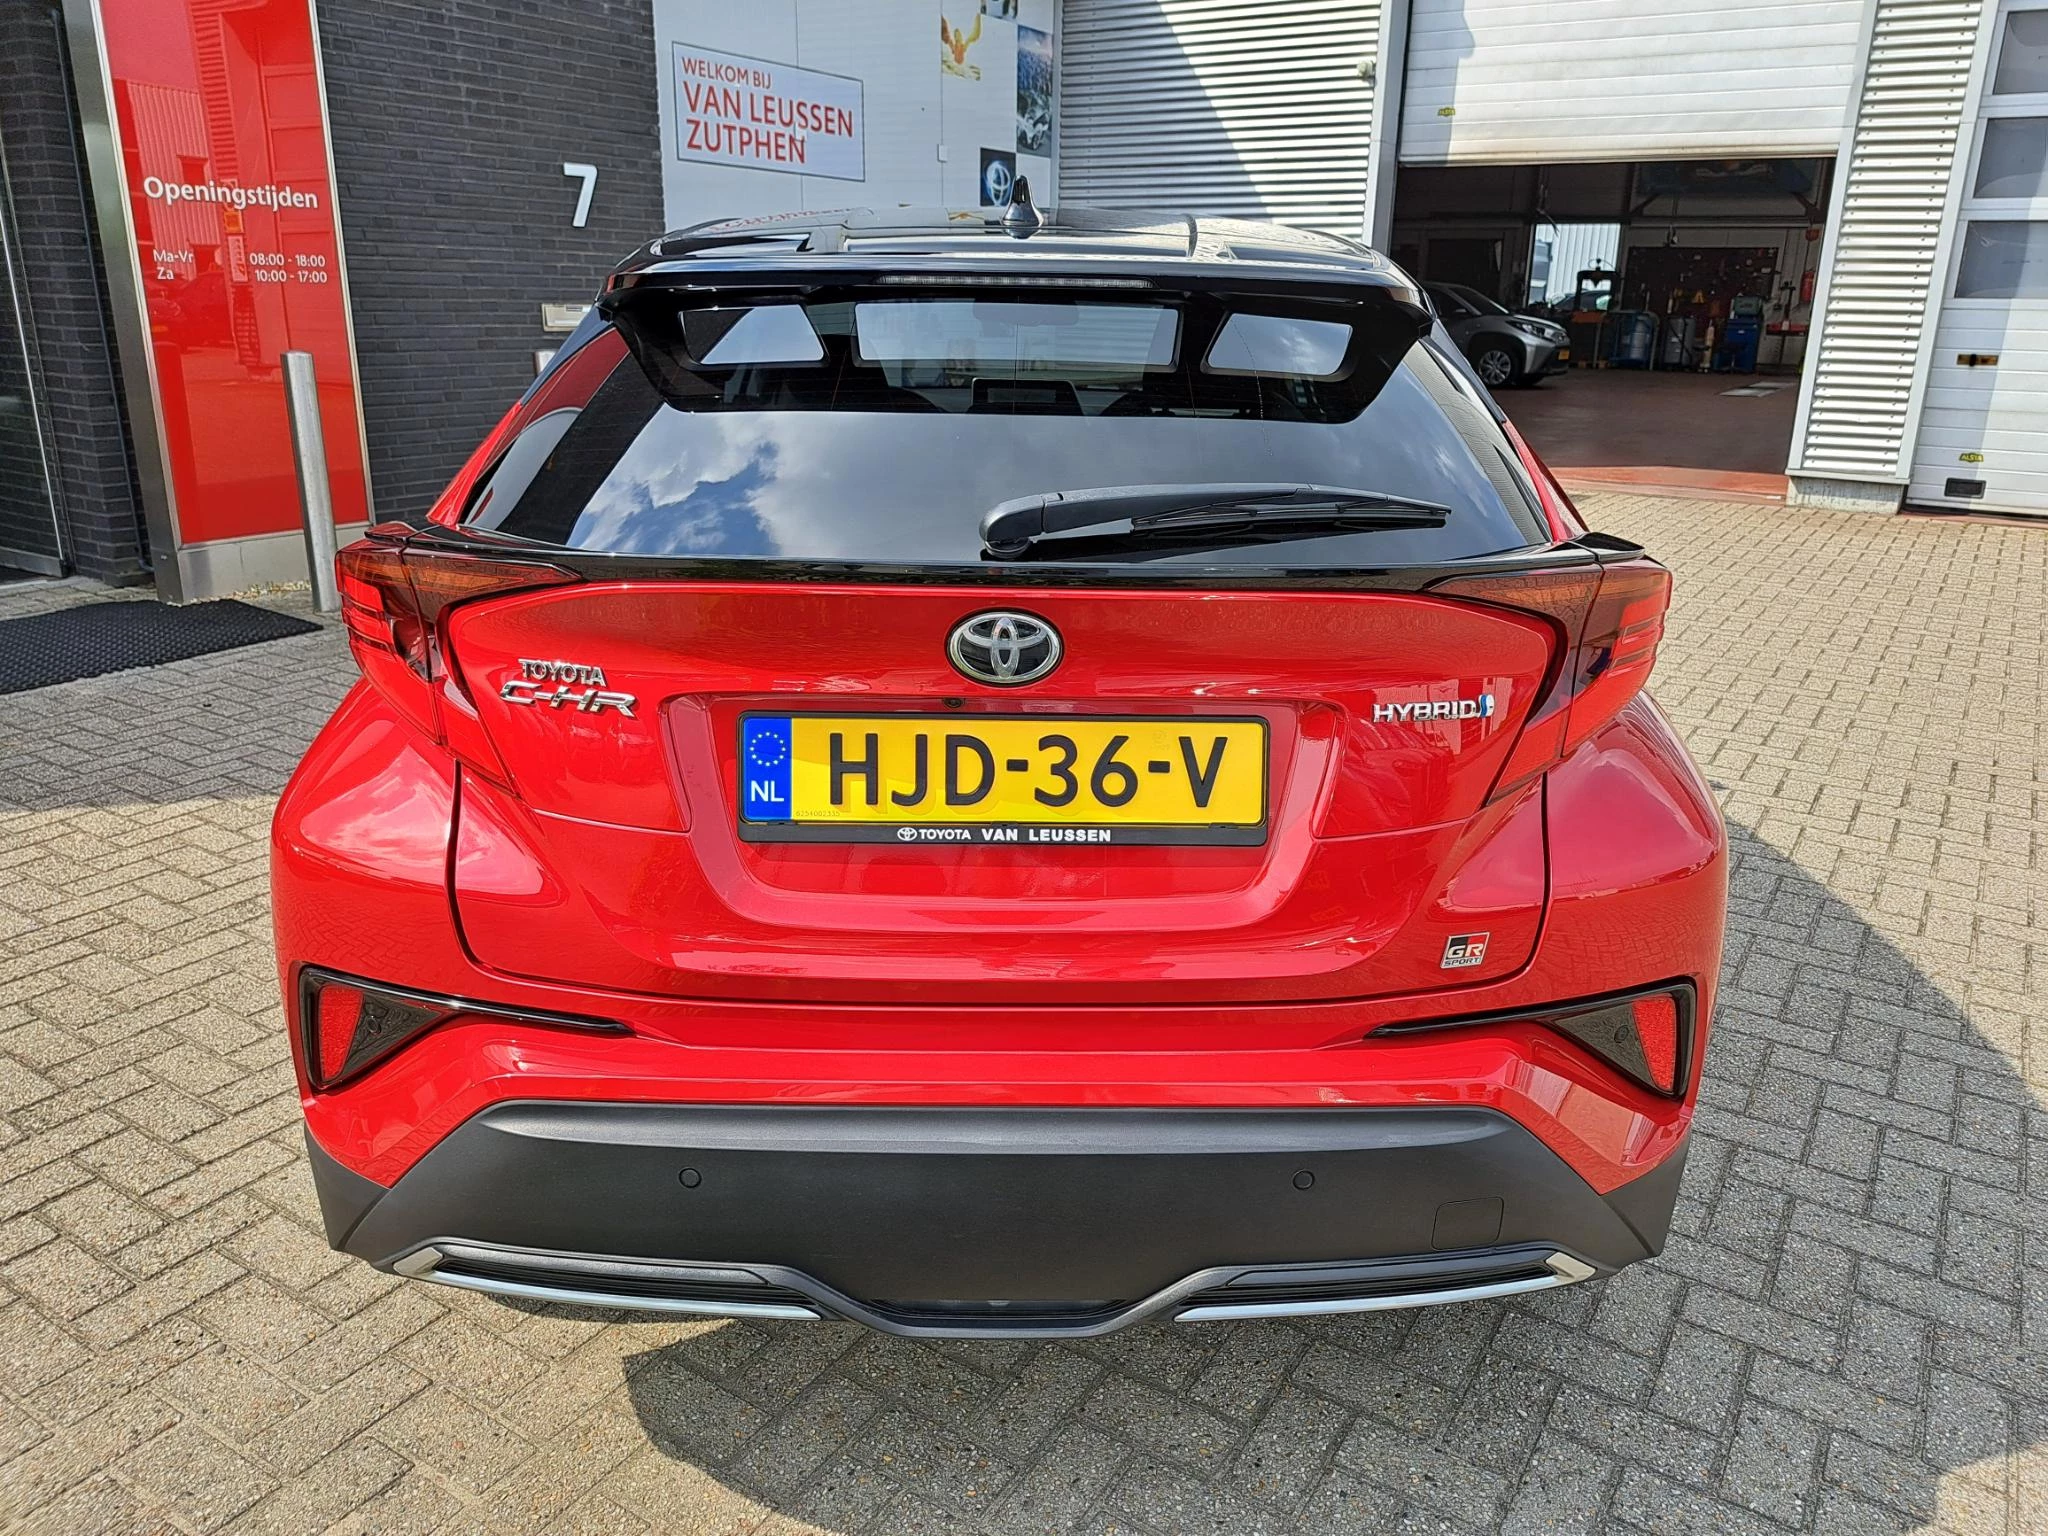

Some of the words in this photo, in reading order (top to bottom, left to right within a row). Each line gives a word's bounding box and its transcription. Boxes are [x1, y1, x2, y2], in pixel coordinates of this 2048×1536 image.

[682, 57, 749, 85] WELKOM
[752, 71, 772, 89] BIJ
[683, 81, 742, 120] VAN
[749, 92, 853, 138] LEUSSEN
[686, 118, 806, 164] ZUTPHEN
[143, 176, 319, 212] Openingstijden
[563, 162, 598, 228] 7
[152, 249, 194, 264] Ma-Vr
[249, 252, 285, 266] 08:00
[295, 254, 326, 267] 18:00
[156, 266, 174, 280] Za
[255, 269, 287, 283] 10:00
[298, 270, 328, 283] 17:00
[518, 658, 606, 687] TOYOTA
[500, 680, 637, 718] C-HR
[1373, 700, 1478, 723] HYBRID
[828, 732, 1228, 808] HJD-36-V
[750, 780, 785, 802] NL
[919, 828, 972, 841] TOYOTA
[981, 828, 1018, 842] VAN
[1028, 829, 1112, 843] LEUSSEN
[1444, 957, 1481, 967] SPORT
[1447, 943, 1484, 959] GR
